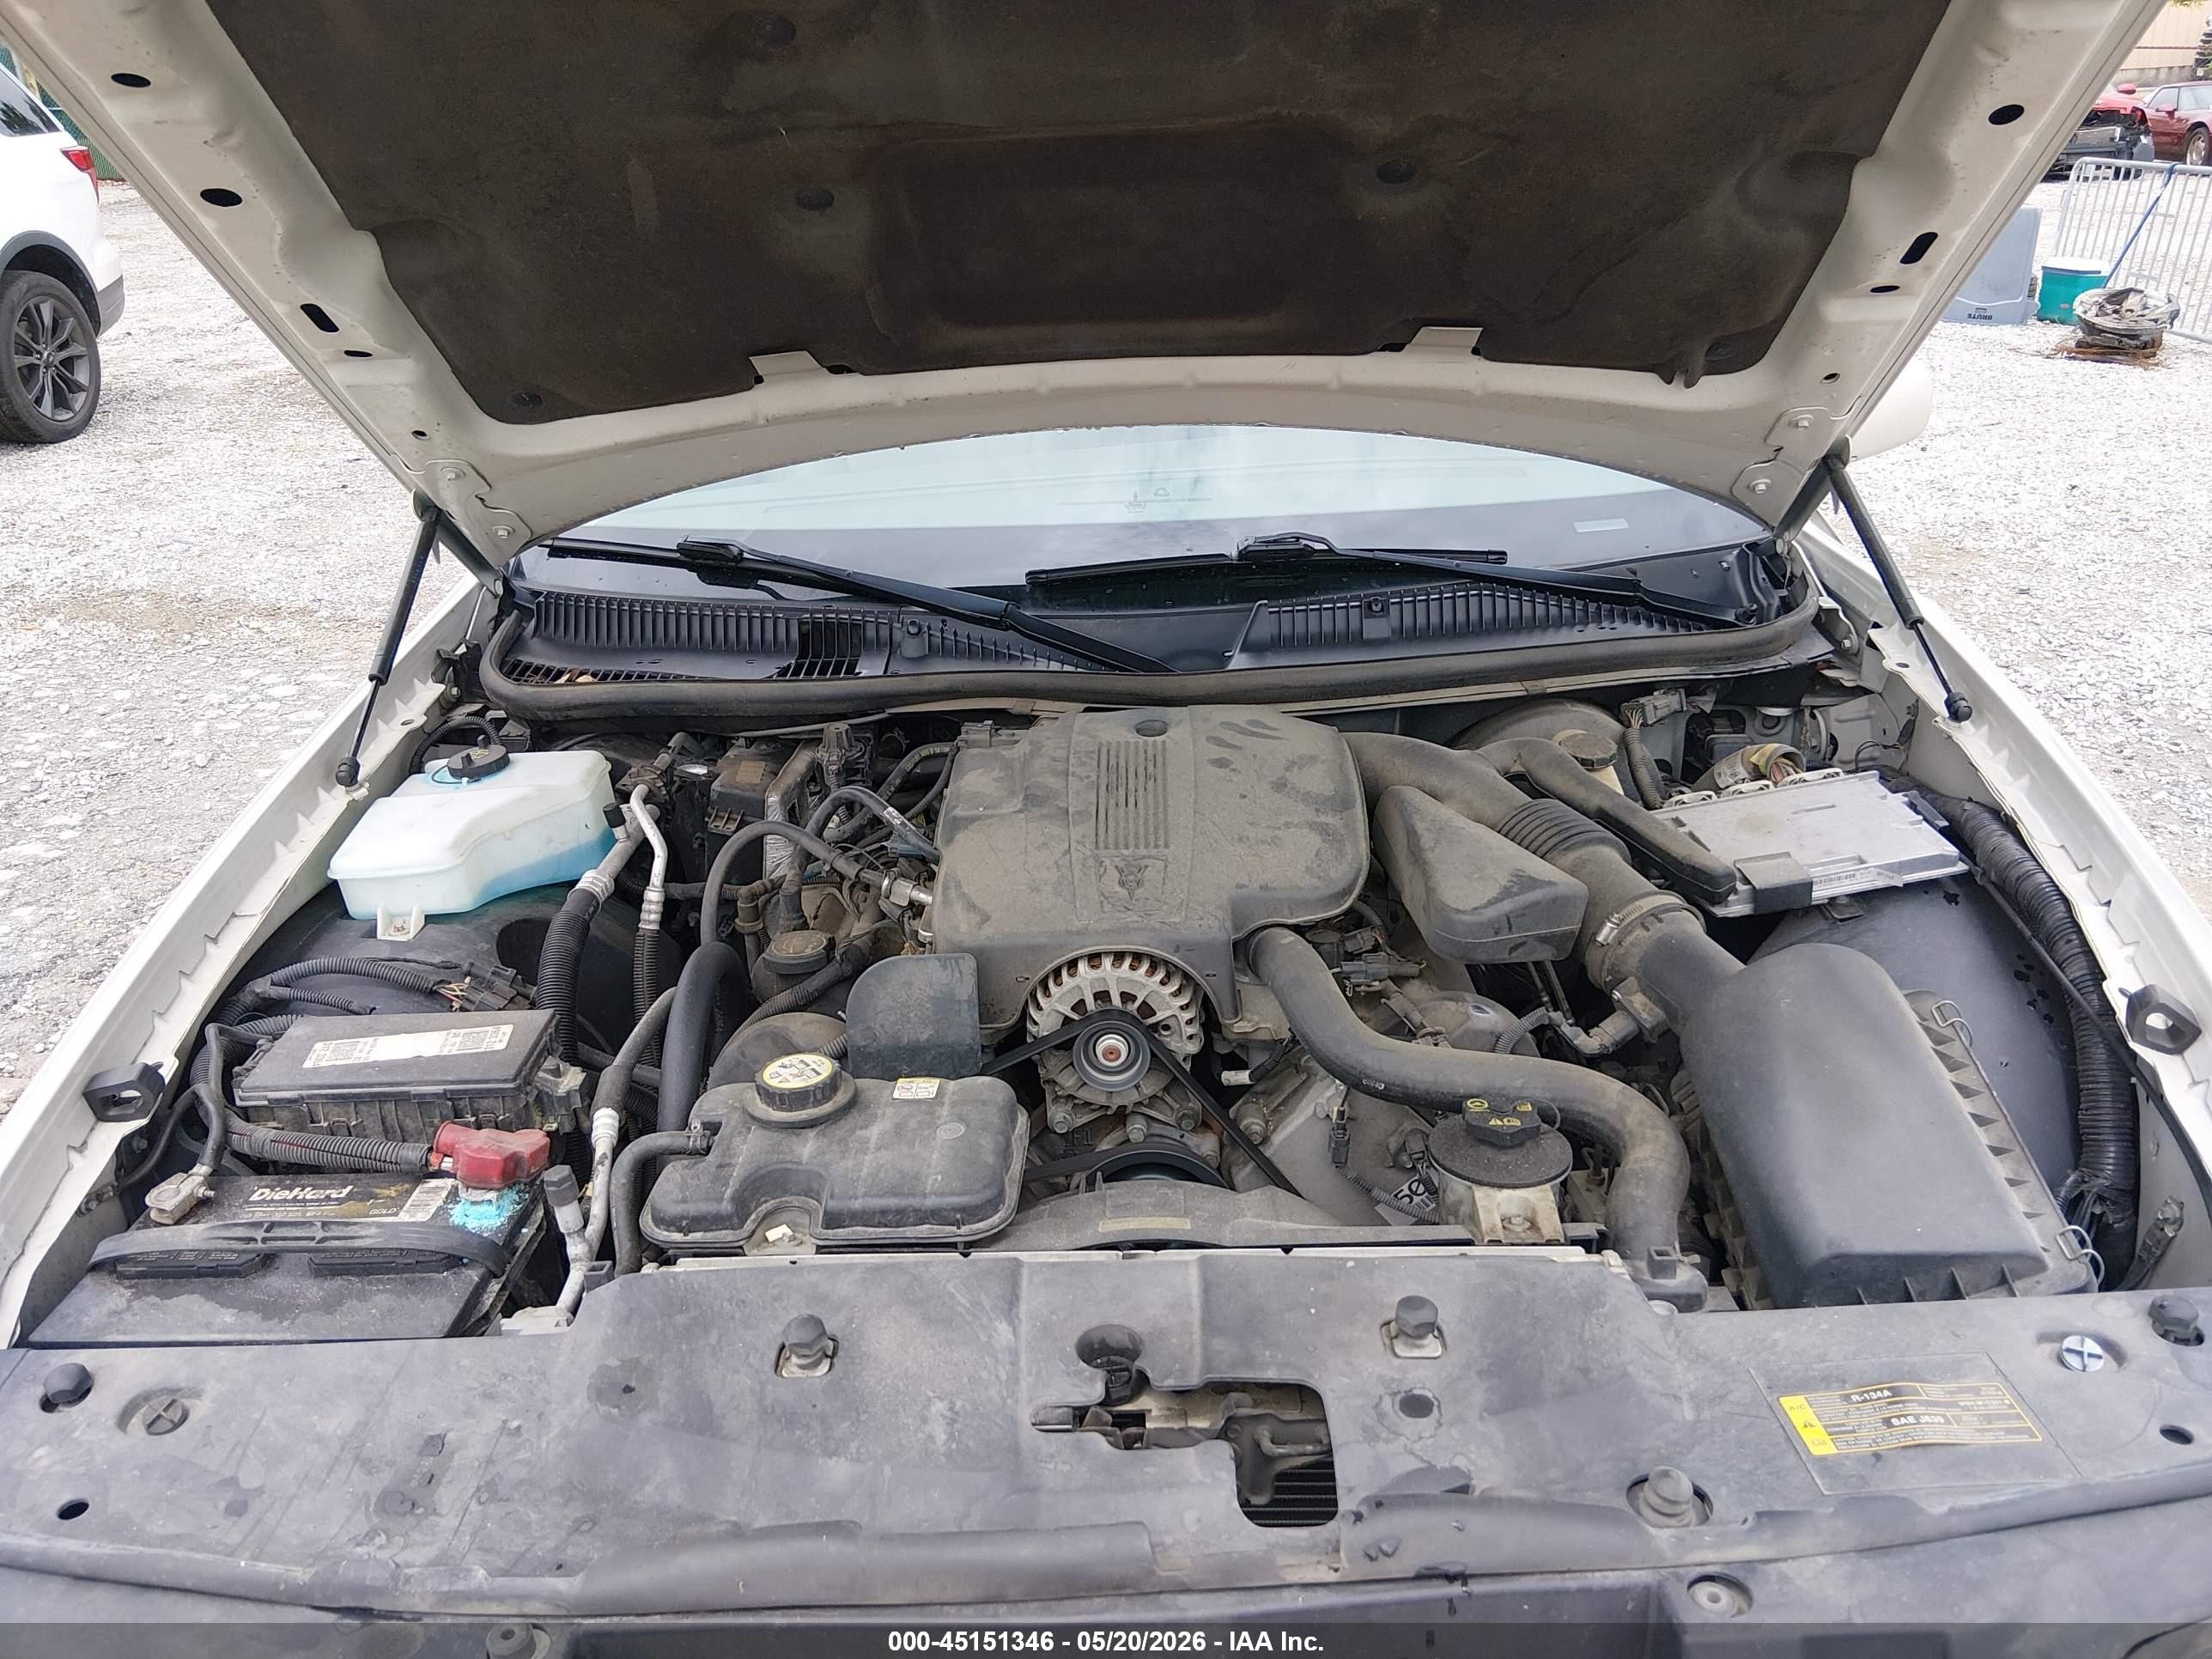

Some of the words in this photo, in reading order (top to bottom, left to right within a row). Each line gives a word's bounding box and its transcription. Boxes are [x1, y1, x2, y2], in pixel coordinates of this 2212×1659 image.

[249, 1186, 354, 1200] DieHard
[1850, 1389, 1893, 1401] R-134A
[1891, 1415, 1917, 1425] SAE
